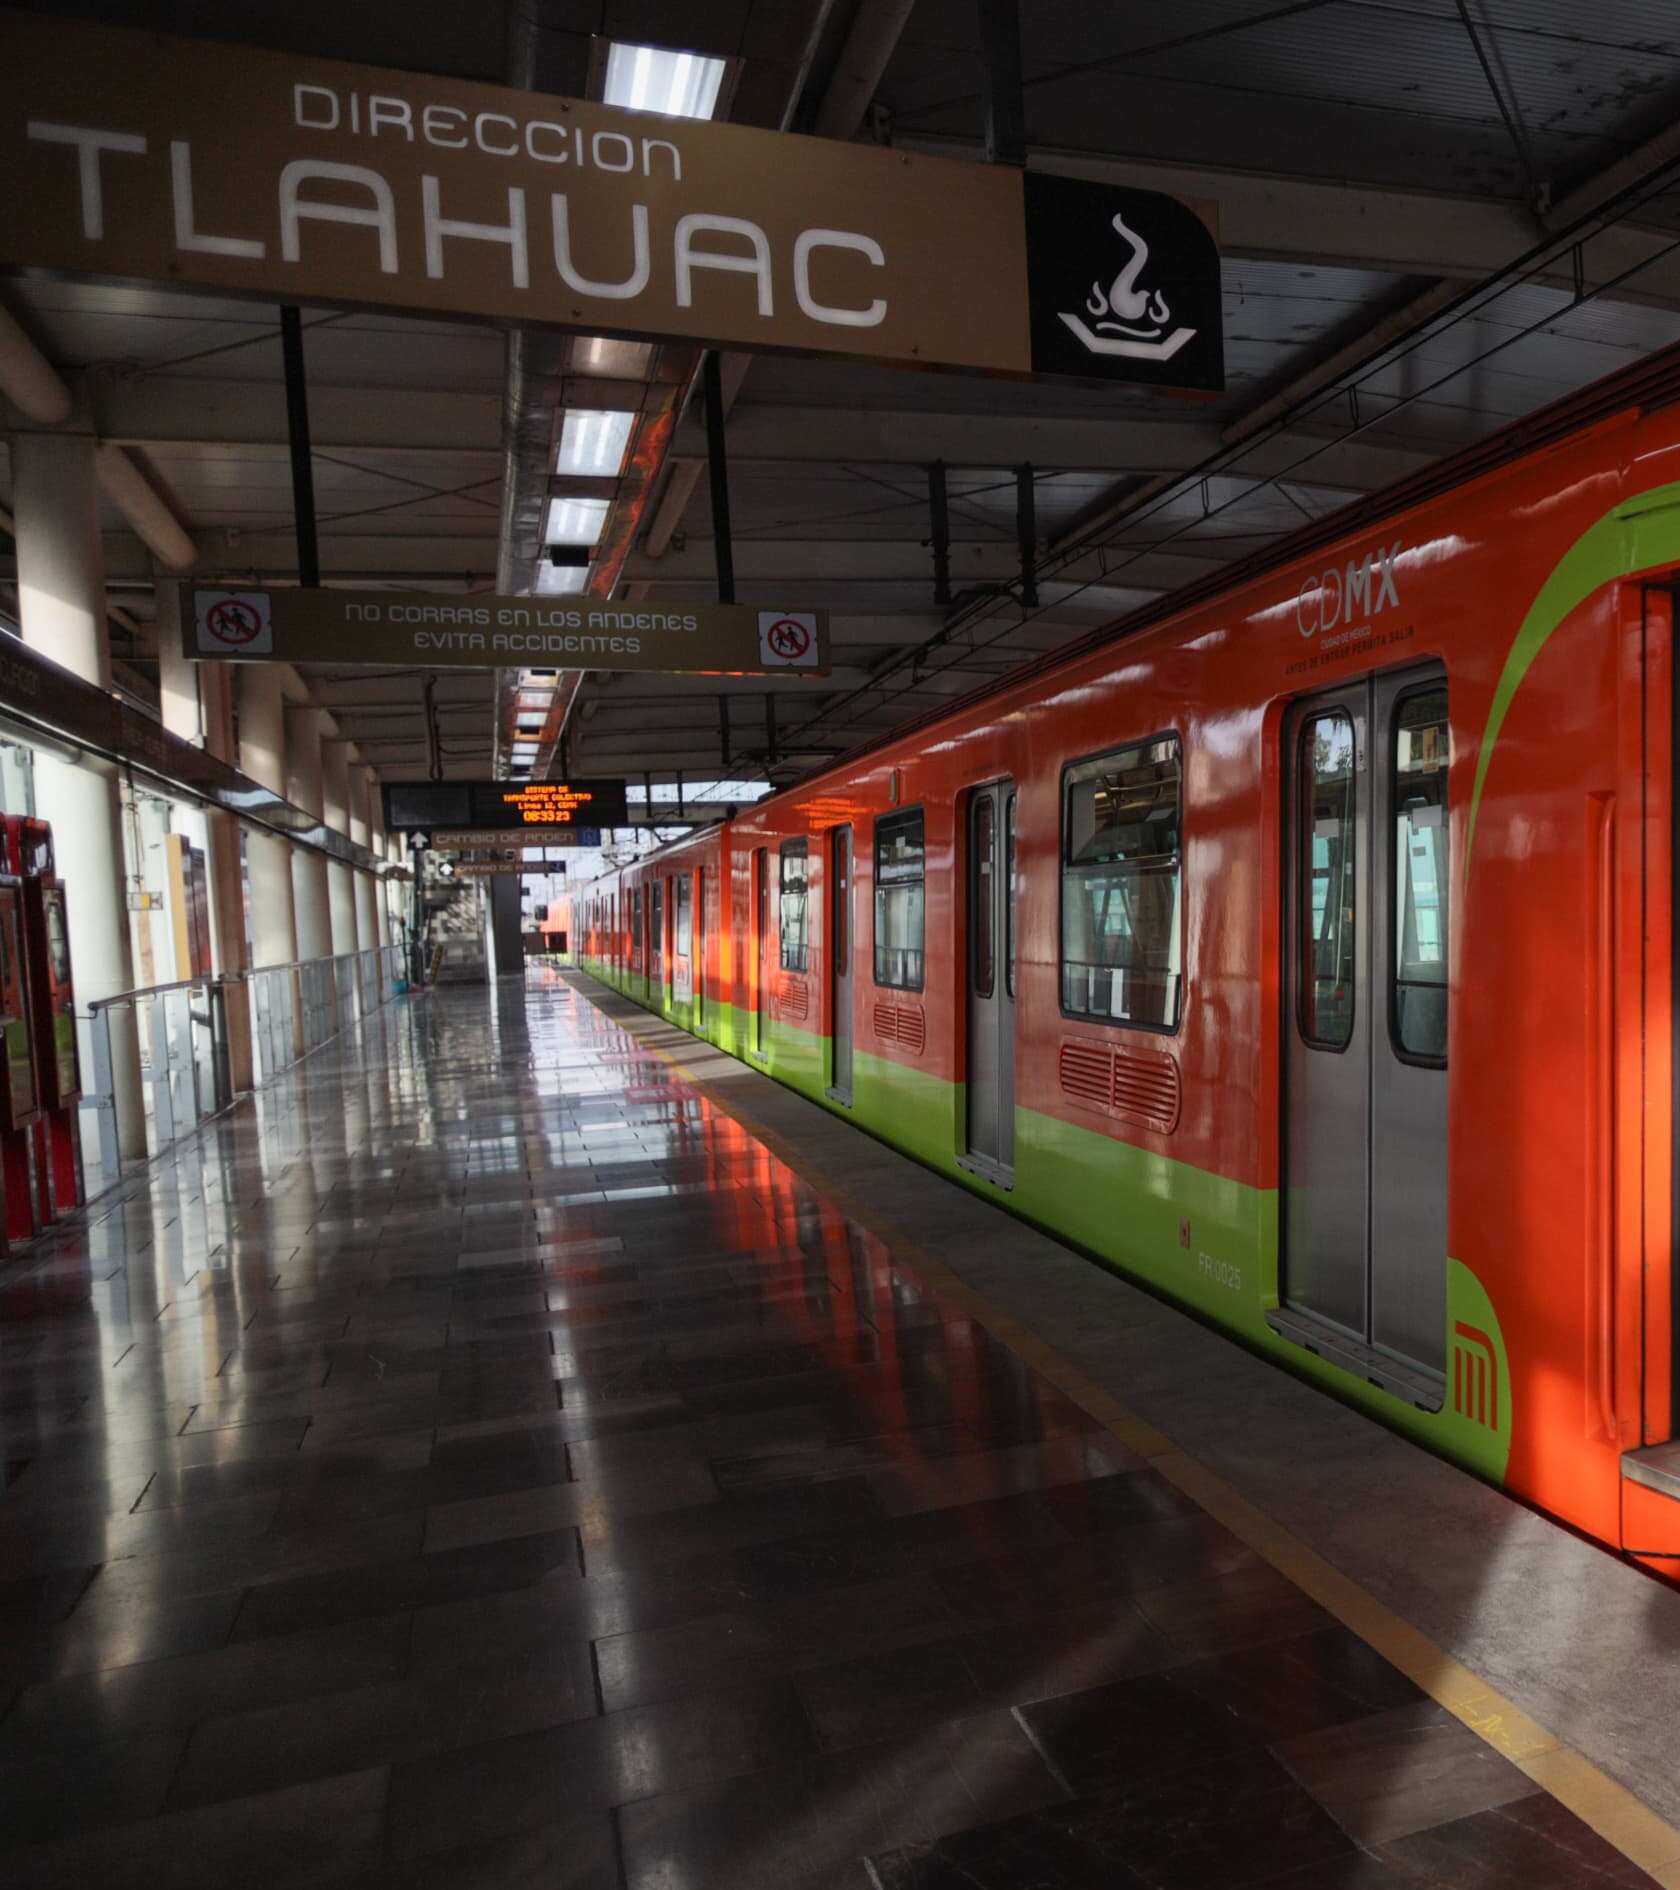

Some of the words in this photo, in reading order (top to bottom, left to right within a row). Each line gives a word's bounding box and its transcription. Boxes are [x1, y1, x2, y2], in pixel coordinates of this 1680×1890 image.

[27, 120, 888, 328] TLAHUAC
[1297, 540, 1402, 638] CDMX
[345, 604, 381, 622] NO
[389, 604, 491, 625] CORRAS
[498, 608, 529, 627] EN
[536, 610, 581, 628] LOS
[588, 612, 698, 632] ANDENES
[414, 632, 485, 650] EVITA
[492, 634, 641, 654] ACCIDENTES
[436, 832, 497, 845] CAMBIO
[499, 832, 521, 844] DE
